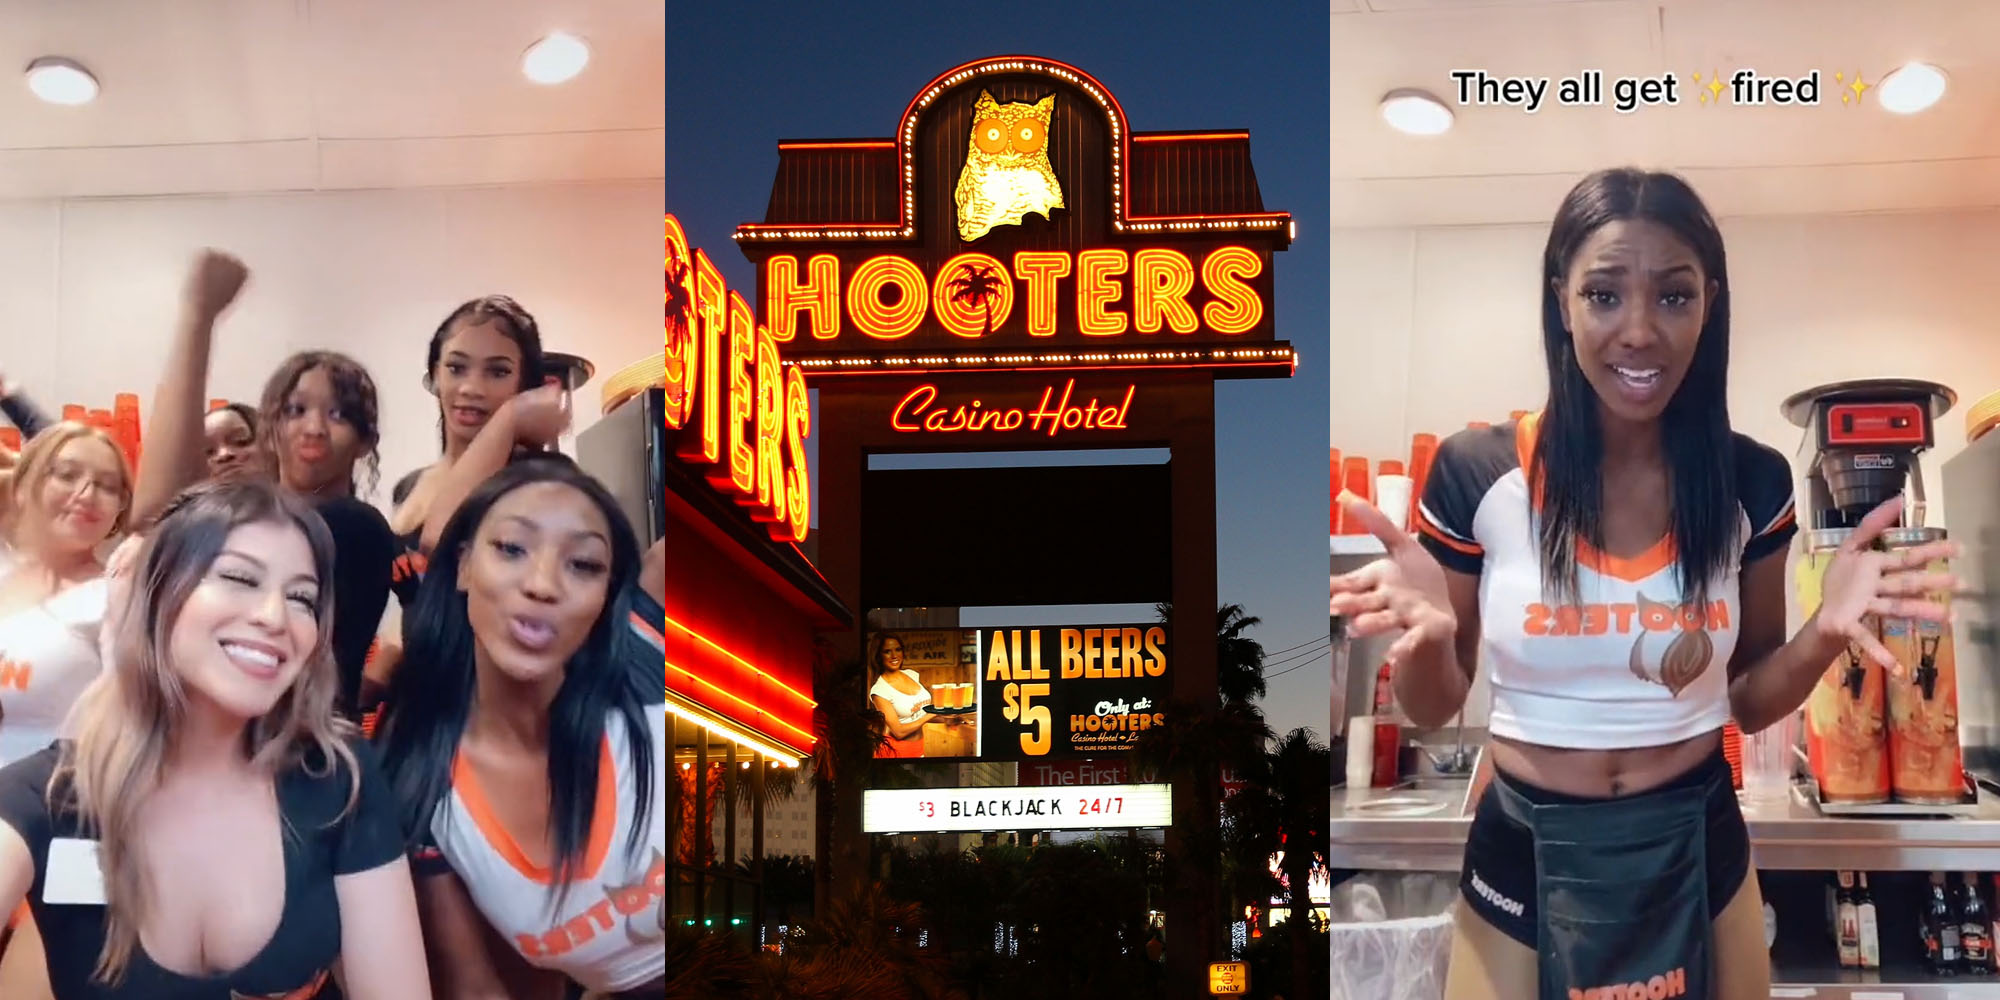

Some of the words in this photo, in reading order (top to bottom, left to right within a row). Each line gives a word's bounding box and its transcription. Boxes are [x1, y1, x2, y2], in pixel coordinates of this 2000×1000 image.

[767, 246, 1263, 341] HOOTERS
[892, 384, 1027, 432] Casino
[1028, 378, 1136, 437] Hotel
[986, 629, 1051, 681] ALL
[1060, 626, 1167, 680] BEERS
[1095, 698, 1130, 716] Only
[1133, 697, 1151, 710] at:
[1002, 682, 1052, 756] $5
[1071, 713, 1165, 731] HOOTERS
[1071, 732, 1097, 743] Casino
[1097, 732, 1119, 743] Hotel
[1036, 765, 1075, 786] The
[1079, 765, 1120, 785] First
[919, 801, 935, 818] $3
[950, 798, 1062, 818] BLACKJACK
[1079, 797, 1123, 815] 24/7
